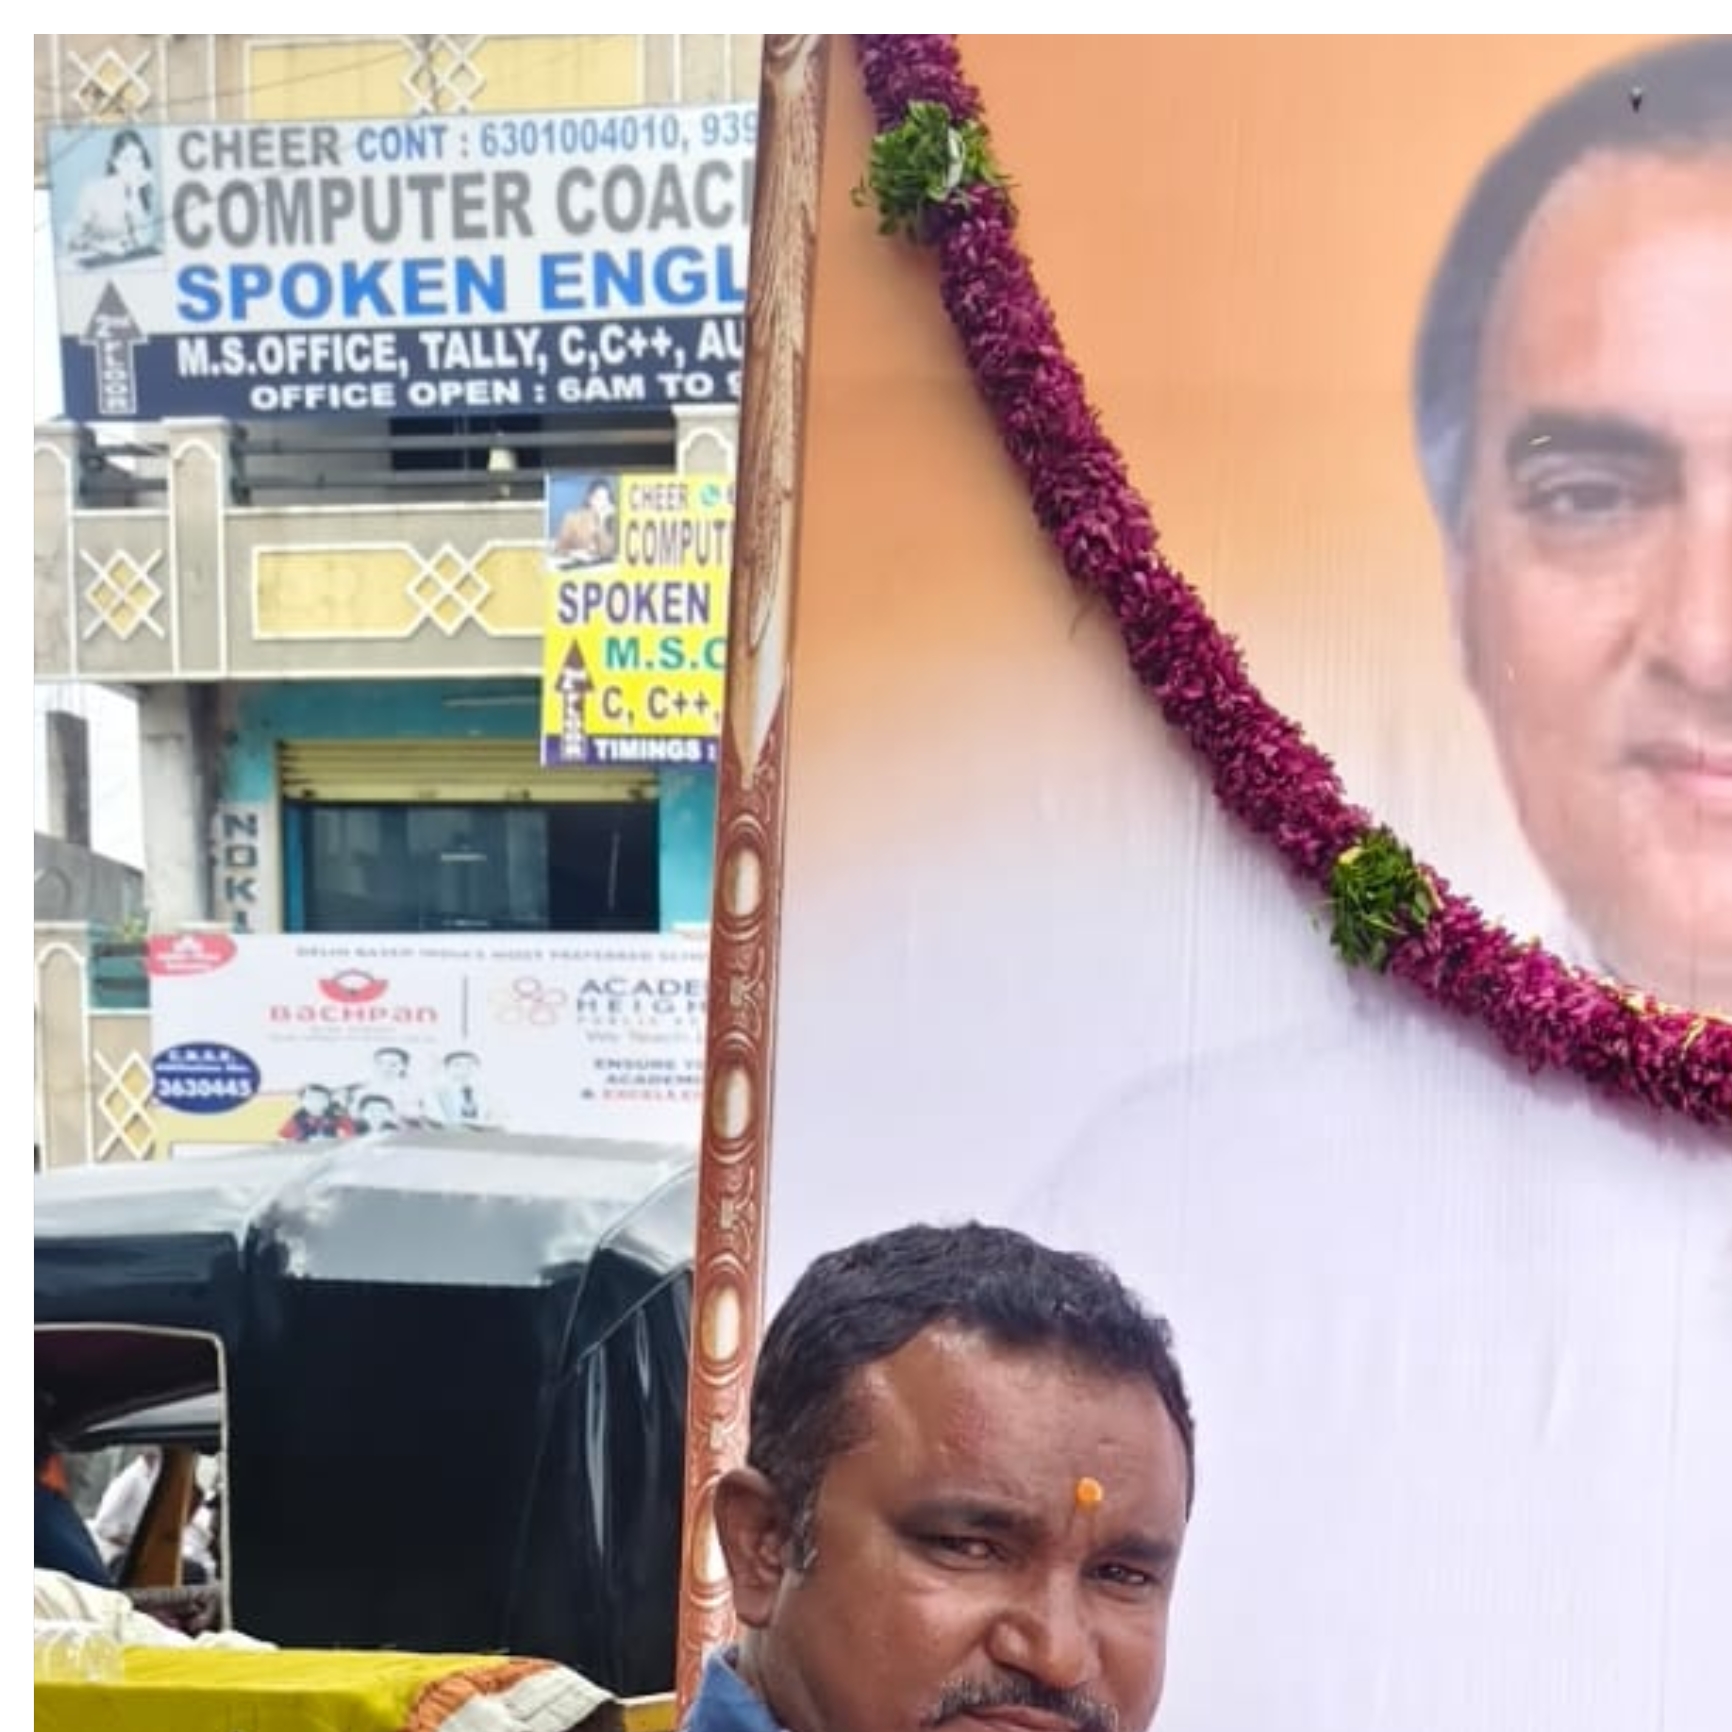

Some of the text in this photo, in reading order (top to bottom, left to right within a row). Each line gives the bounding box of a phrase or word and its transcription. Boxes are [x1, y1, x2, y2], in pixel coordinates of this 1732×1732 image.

[178, 126, 340, 171] CHEER
[356, 124, 447, 162] CONT
[480, 114, 689, 157] 6301004010,
[172, 171, 534, 249] COMPUTER
[177, 245, 748, 322] SPOKEN ENGL
[176, 331, 409, 379] M.S.OFFICE,
[419, 327, 547, 375] TALLY,
[559, 323, 686, 373] C,C++,
[250, 382, 397, 410] OFFICE
[407, 377, 521, 406] OPEN
[556, 375, 645, 402] 6AM
[657, 371, 714, 399] TO
[558, 580, 711, 626] SPOKEN
[602, 686, 635, 726] C,
[595, 738, 702, 762] TIMINGS
